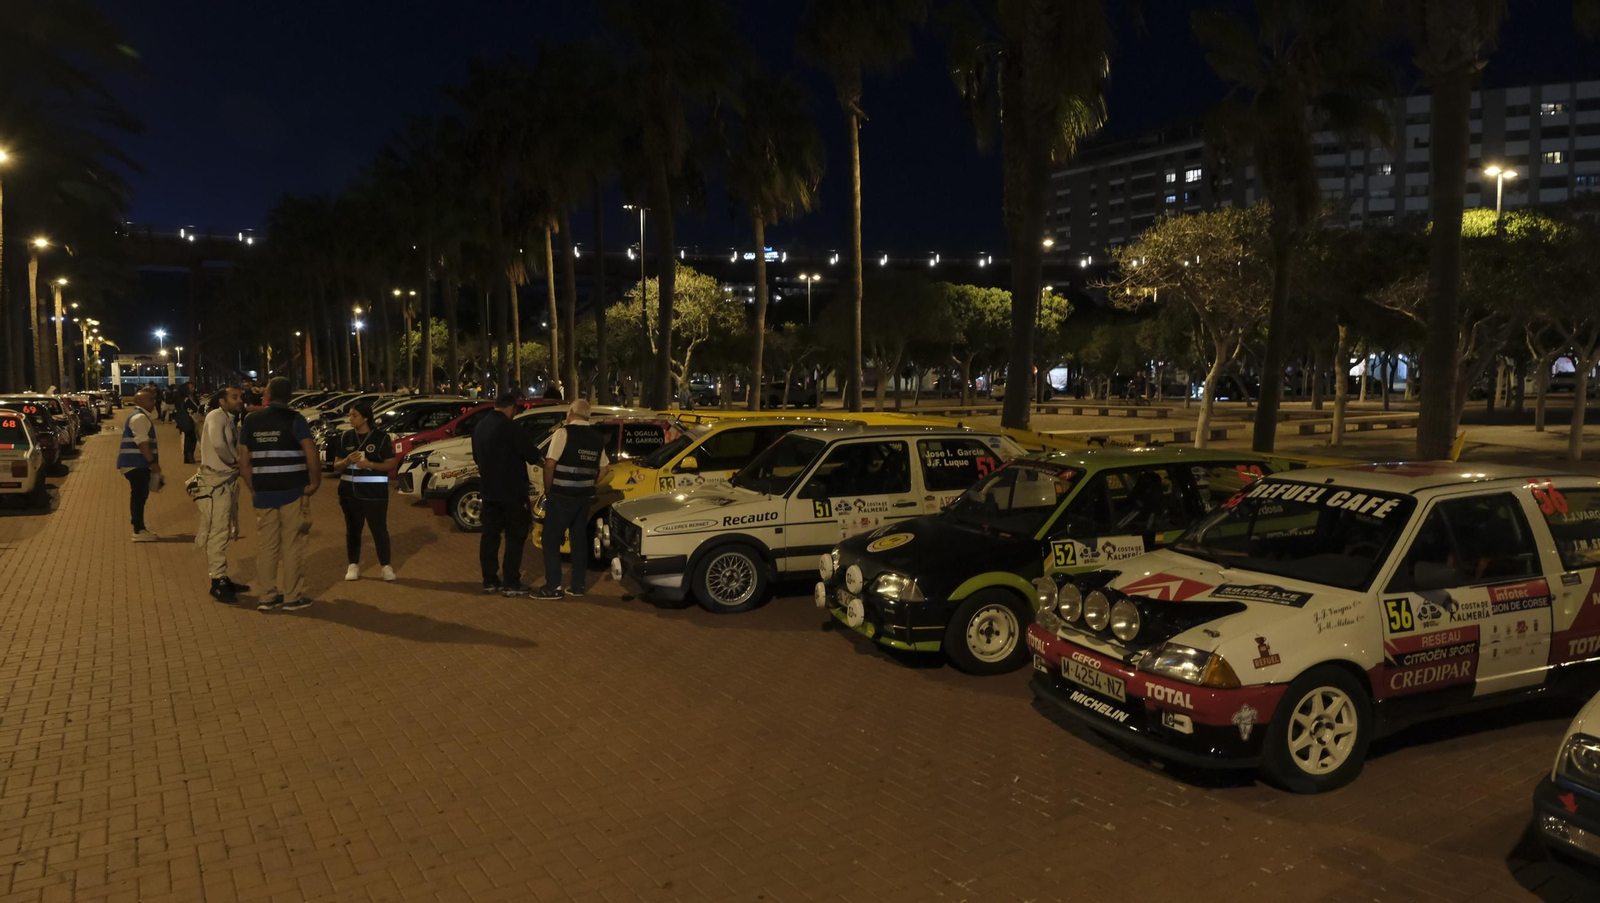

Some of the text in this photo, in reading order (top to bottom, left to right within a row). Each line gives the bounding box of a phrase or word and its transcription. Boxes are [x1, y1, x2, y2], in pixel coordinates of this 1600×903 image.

[23, 405, 37, 414] 69
[2, 420, 16, 428] 68
[635, 437, 664, 445] GARRIDO
[925, 450, 945, 458] Jose
[943, 458, 970, 467] Luque
[976, 456, 996, 480] 51
[660, 478, 675, 491] 33
[1247, 483, 1327, 504] REFUEL
[1526, 478, 1569, 516] 56
[814, 500, 830, 517] 51
[722, 511, 779, 527] Recauto
[1054, 544, 1075, 567] 52
[1494, 587, 1530, 601] infotec
[1510, 601, 1521, 610] DE
[1522, 597, 1548, 608] CORSE
[1386, 600, 1413, 631] 56
[1456, 607, 1491, 622] ALMERÍA
[1421, 630, 1461, 648] RESEAU
[1072, 651, 1101, 669] GEFCO
[1254, 655, 1279, 667] REFUEL
[1403, 649, 1447, 666] CITROËN
[1448, 643, 1476, 657] SPORT
[1390, 660, 1471, 690] CREDIPAR
[1145, 682, 1194, 709] TOTAL
[1069, 690, 1130, 723] MICHELIN
